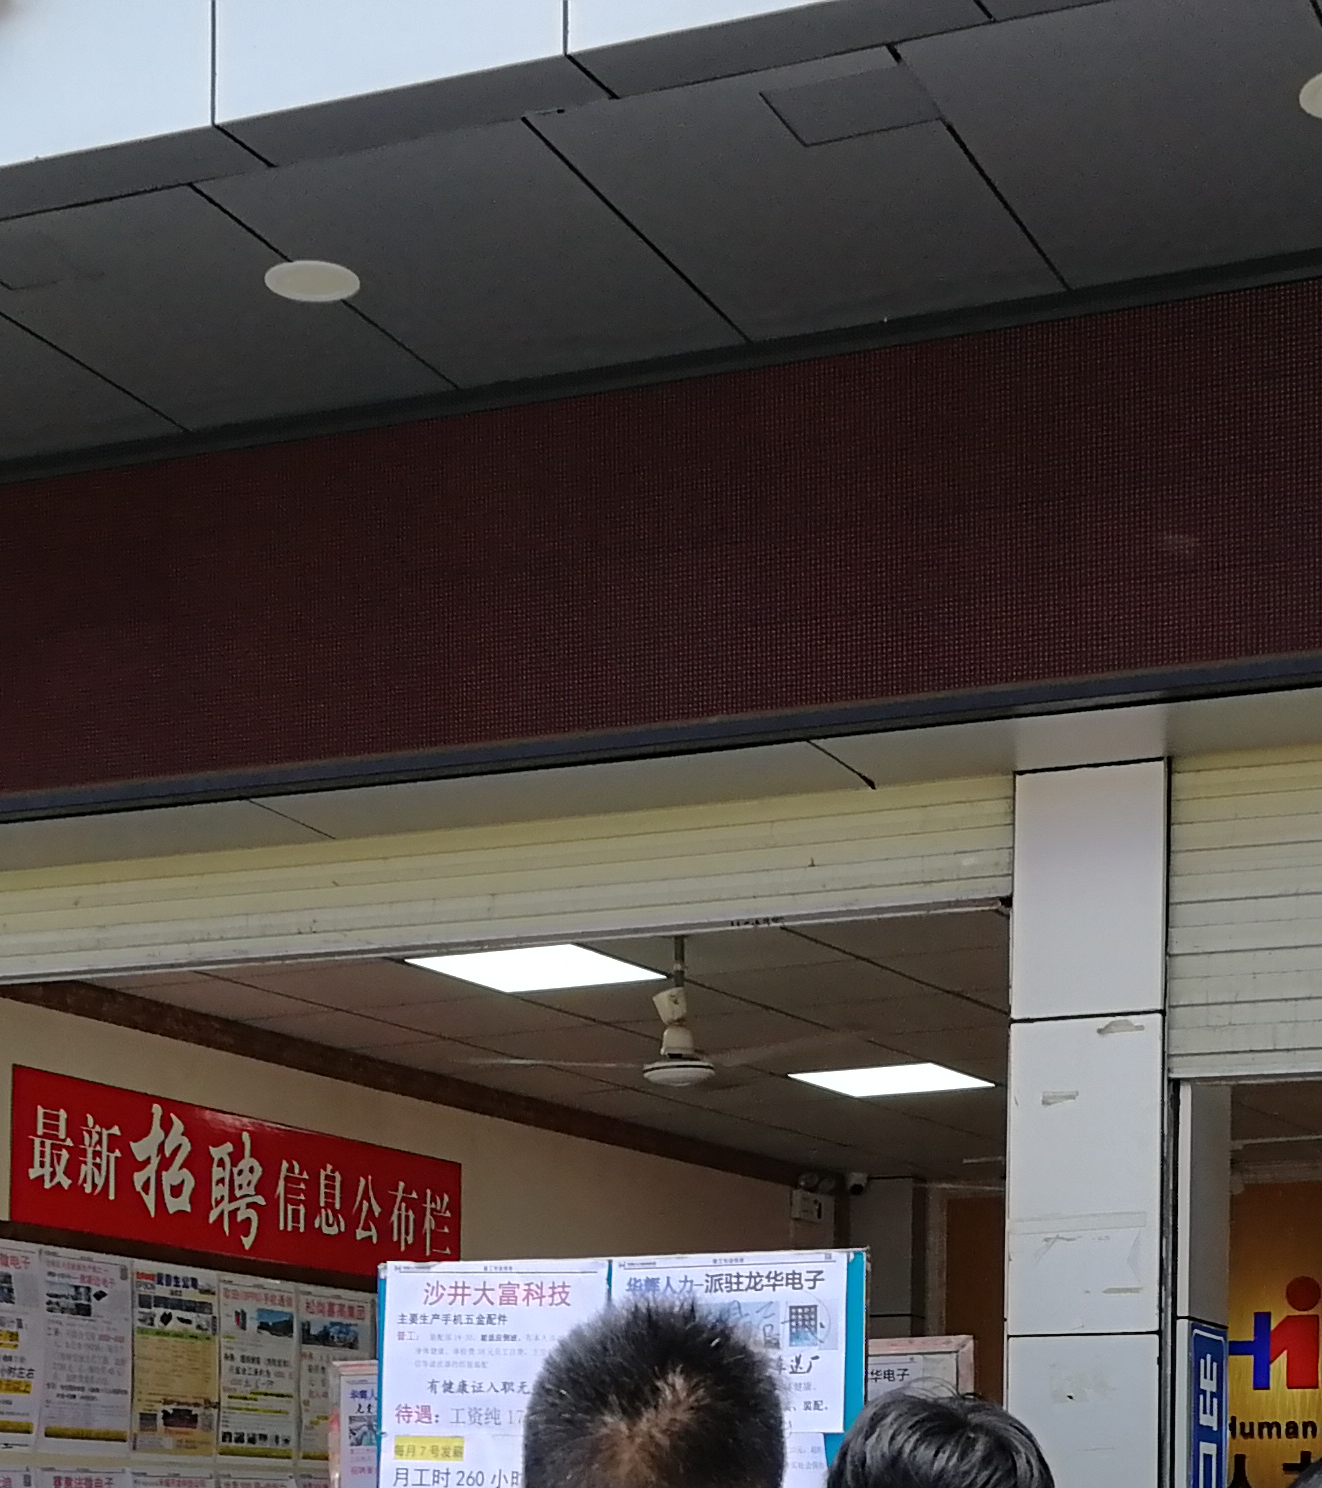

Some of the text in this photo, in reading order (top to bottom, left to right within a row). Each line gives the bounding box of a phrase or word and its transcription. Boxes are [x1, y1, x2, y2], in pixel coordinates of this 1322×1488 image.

[28, 1103, 452, 1257] 最新招聘信息公布栏
[423, 1280, 572, 1308] 沙井大富科技
[397, 1313, 508, 1326] 主要生产手机五金配件
[870, 1368, 910, 1382] 华电子
